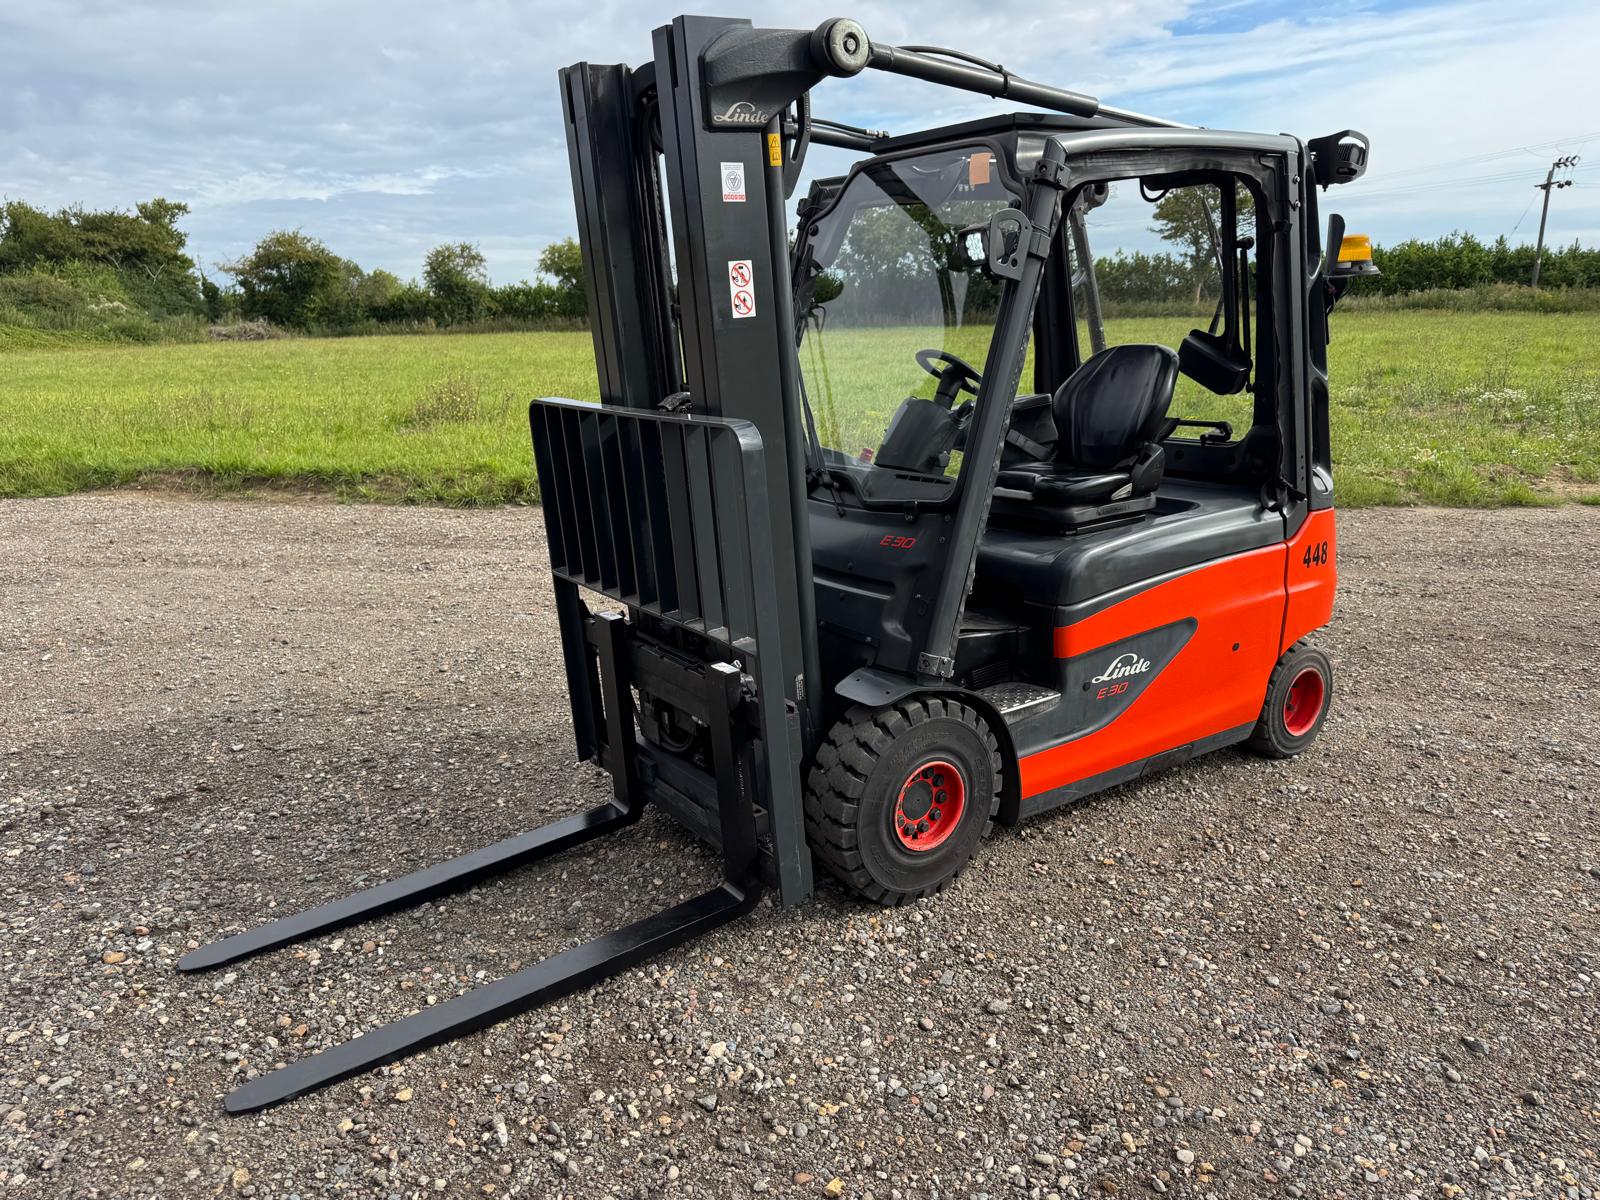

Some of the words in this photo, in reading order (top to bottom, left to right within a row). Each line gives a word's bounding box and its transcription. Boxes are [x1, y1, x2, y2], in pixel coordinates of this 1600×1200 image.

[714, 101, 769, 123] Linde
[1303, 541, 1328, 568] 448
[1091, 653, 1151, 684] Linde
